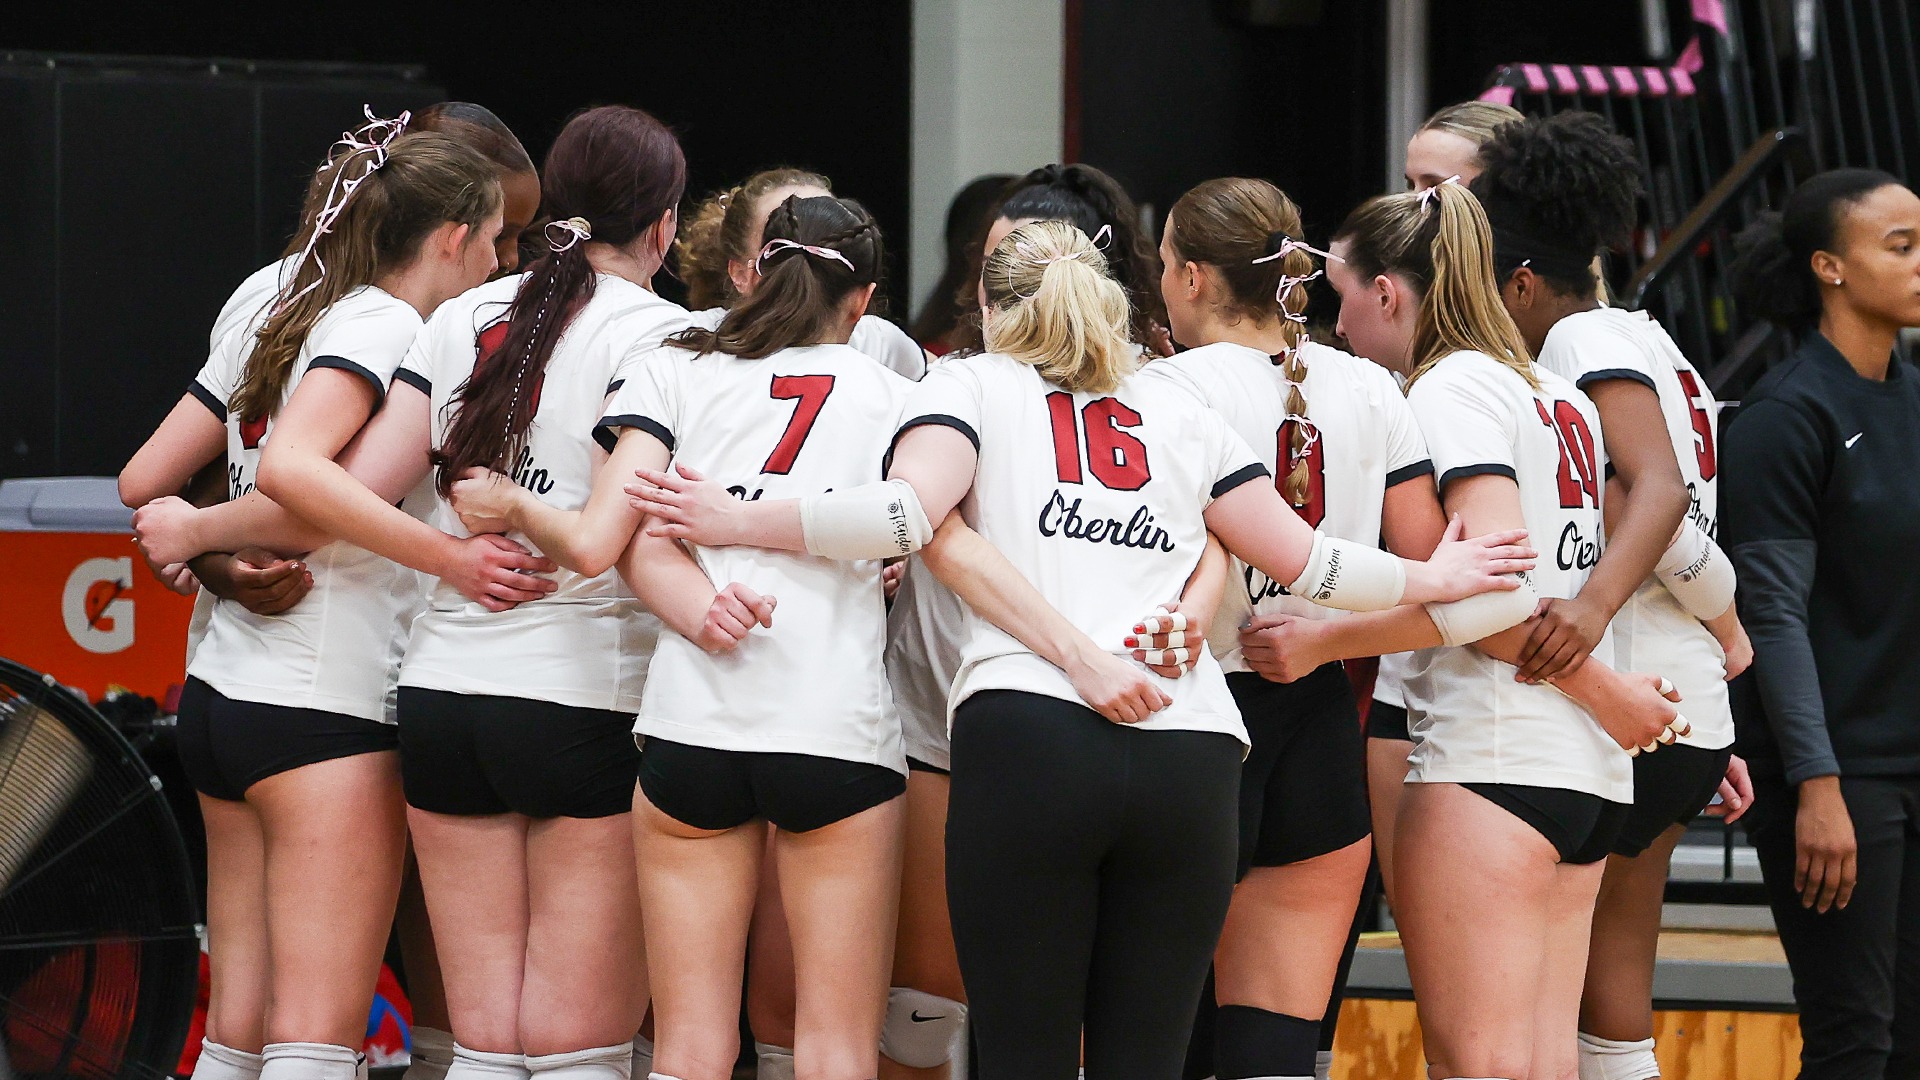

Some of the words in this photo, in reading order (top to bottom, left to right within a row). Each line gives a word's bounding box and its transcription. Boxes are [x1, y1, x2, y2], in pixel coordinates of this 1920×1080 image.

[759, 373, 836, 475] 7
[1045, 391, 1152, 492] 16
[1674, 368, 1717, 483] 5
[1038, 489, 1176, 553] Oberlin
[61, 556, 135, 654] G
